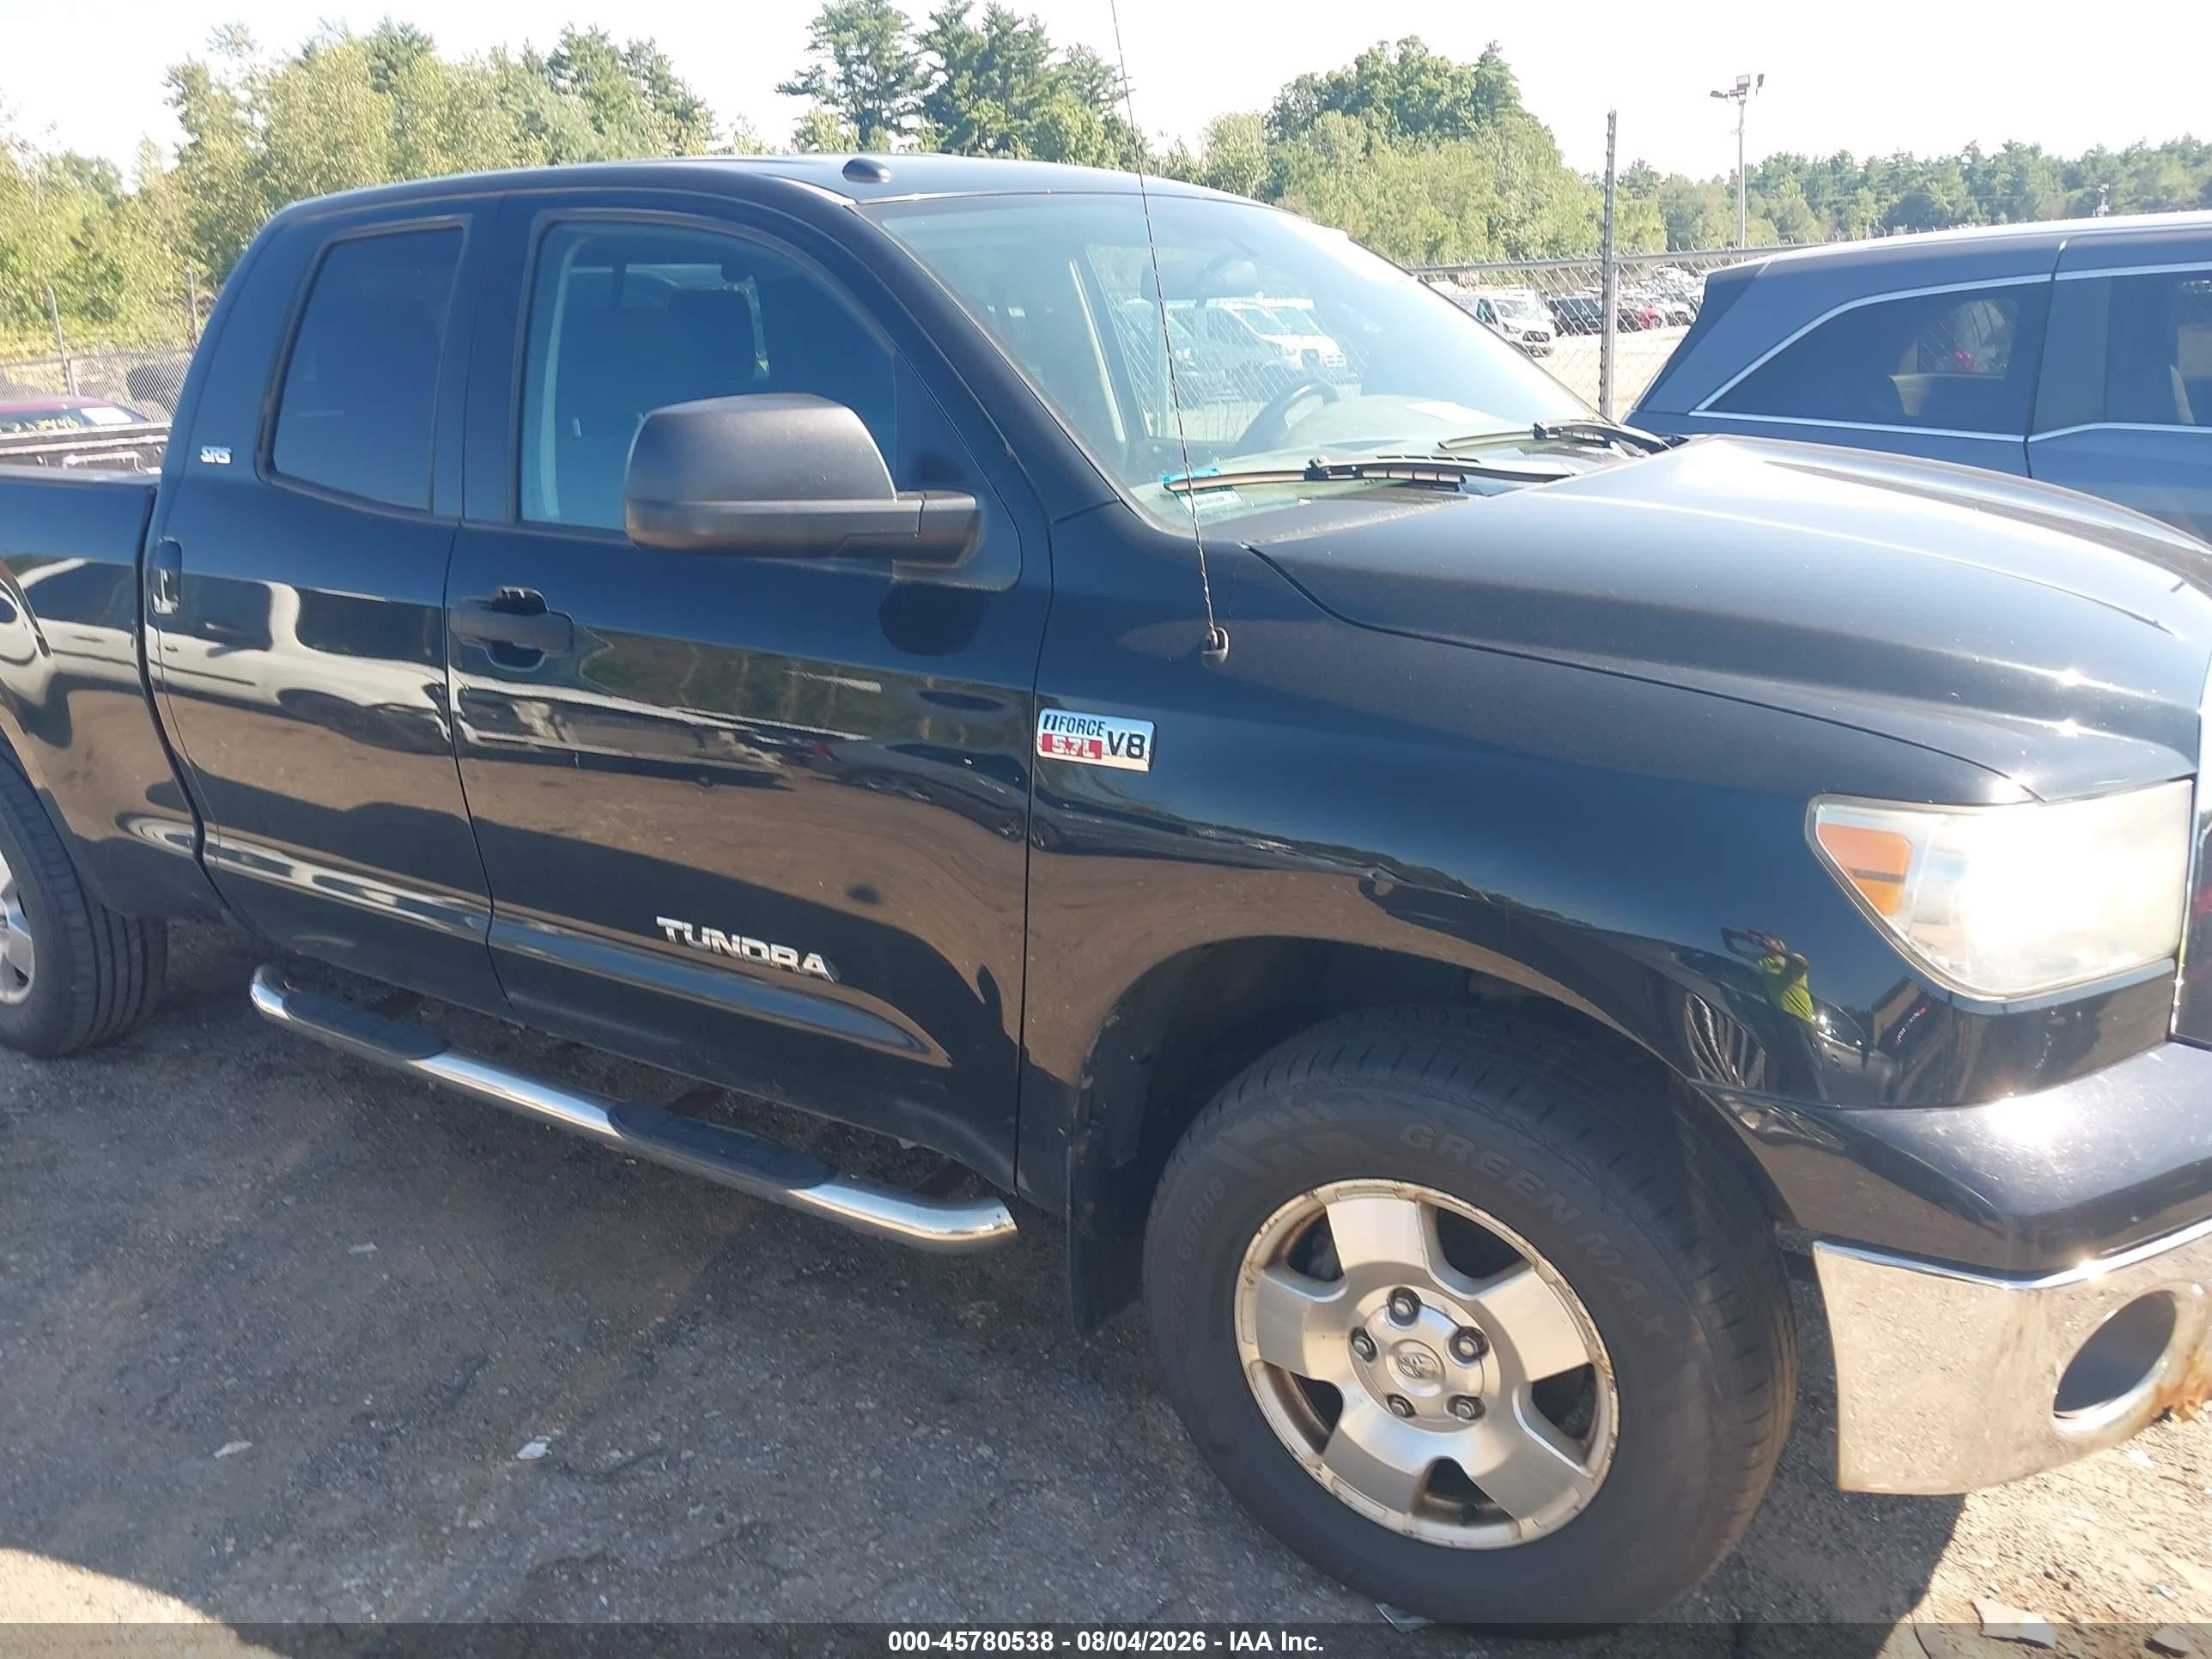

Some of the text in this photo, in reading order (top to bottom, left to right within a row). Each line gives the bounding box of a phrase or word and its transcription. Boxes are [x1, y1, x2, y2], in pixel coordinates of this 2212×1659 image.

[1051, 734, 1097, 759] 5.7L
[1108, 731, 1146, 759] V8
[656, 915, 836, 982] TUNDRA
[1400, 1122, 1672, 1338] GREEN MAX
